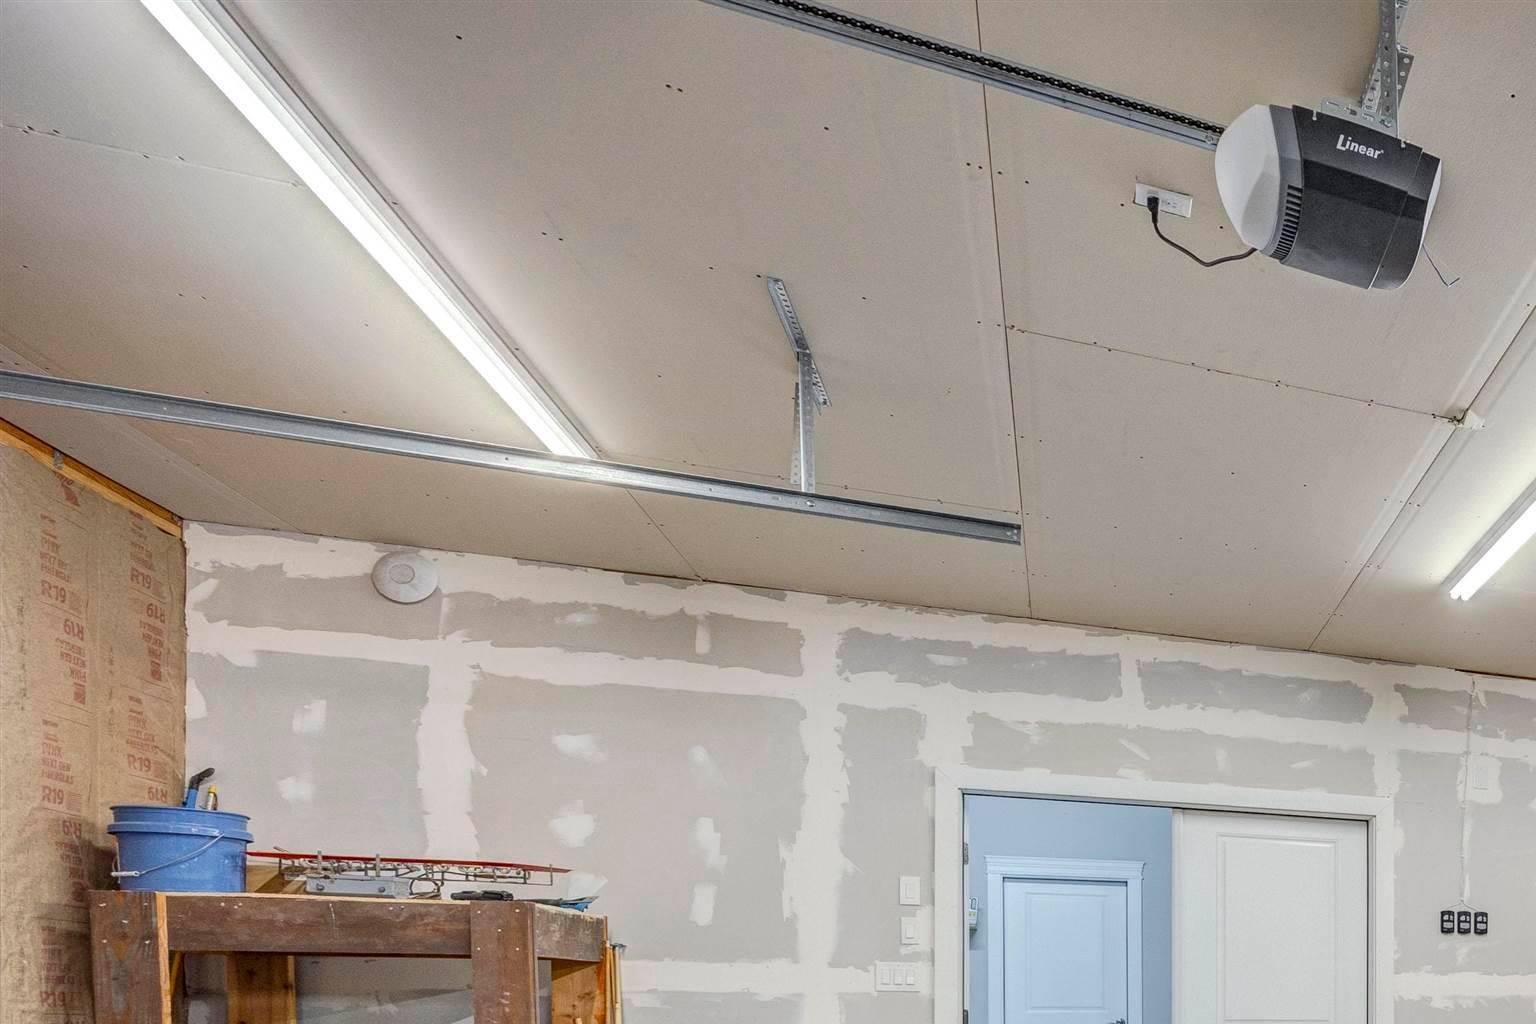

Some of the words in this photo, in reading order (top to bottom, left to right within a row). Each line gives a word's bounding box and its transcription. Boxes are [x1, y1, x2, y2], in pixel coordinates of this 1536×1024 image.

[1336, 134, 1382, 159] Linear
[131, 567, 152, 589] R19
[41, 579, 67, 603] R19
[64, 619, 85, 641] R19
[127, 754, 152, 773] R19
[42, 785, 65, 805] R19
[147, 786, 168, 803] R19
